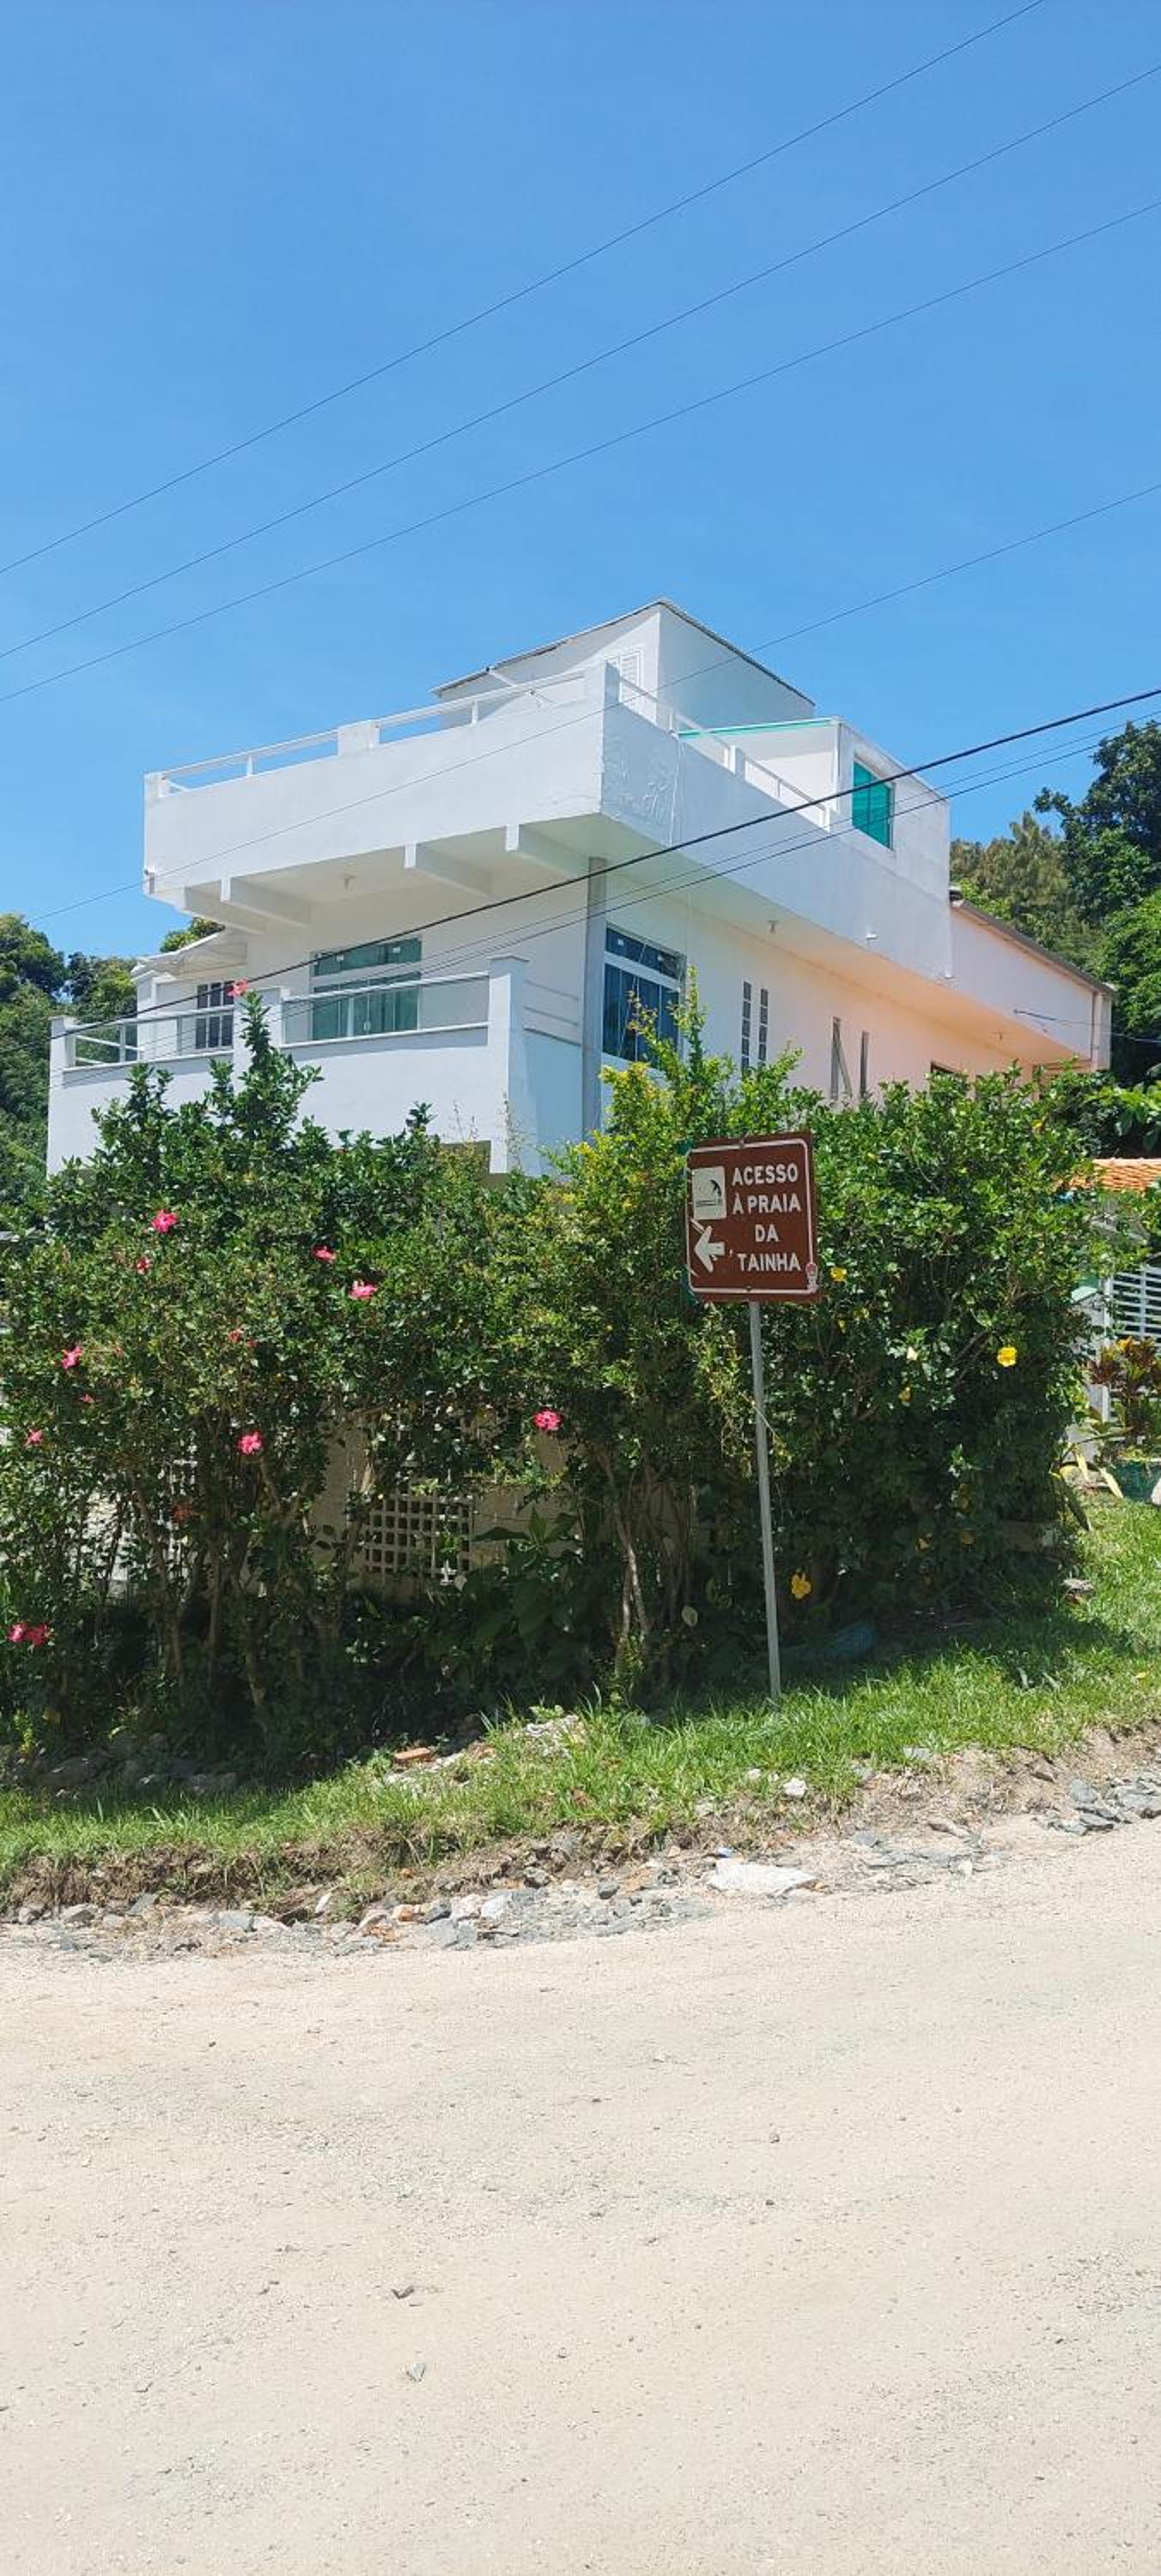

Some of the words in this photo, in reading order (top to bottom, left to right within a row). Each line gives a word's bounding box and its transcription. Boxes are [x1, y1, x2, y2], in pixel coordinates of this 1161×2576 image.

[732, 1163, 799, 1187] ACESSO
[732, 1193, 745, 1215] À
[748, 1193, 802, 1214] PRAIA
[755, 1224, 780, 1242] DA
[738, 1253, 802, 1272] TAINHA
